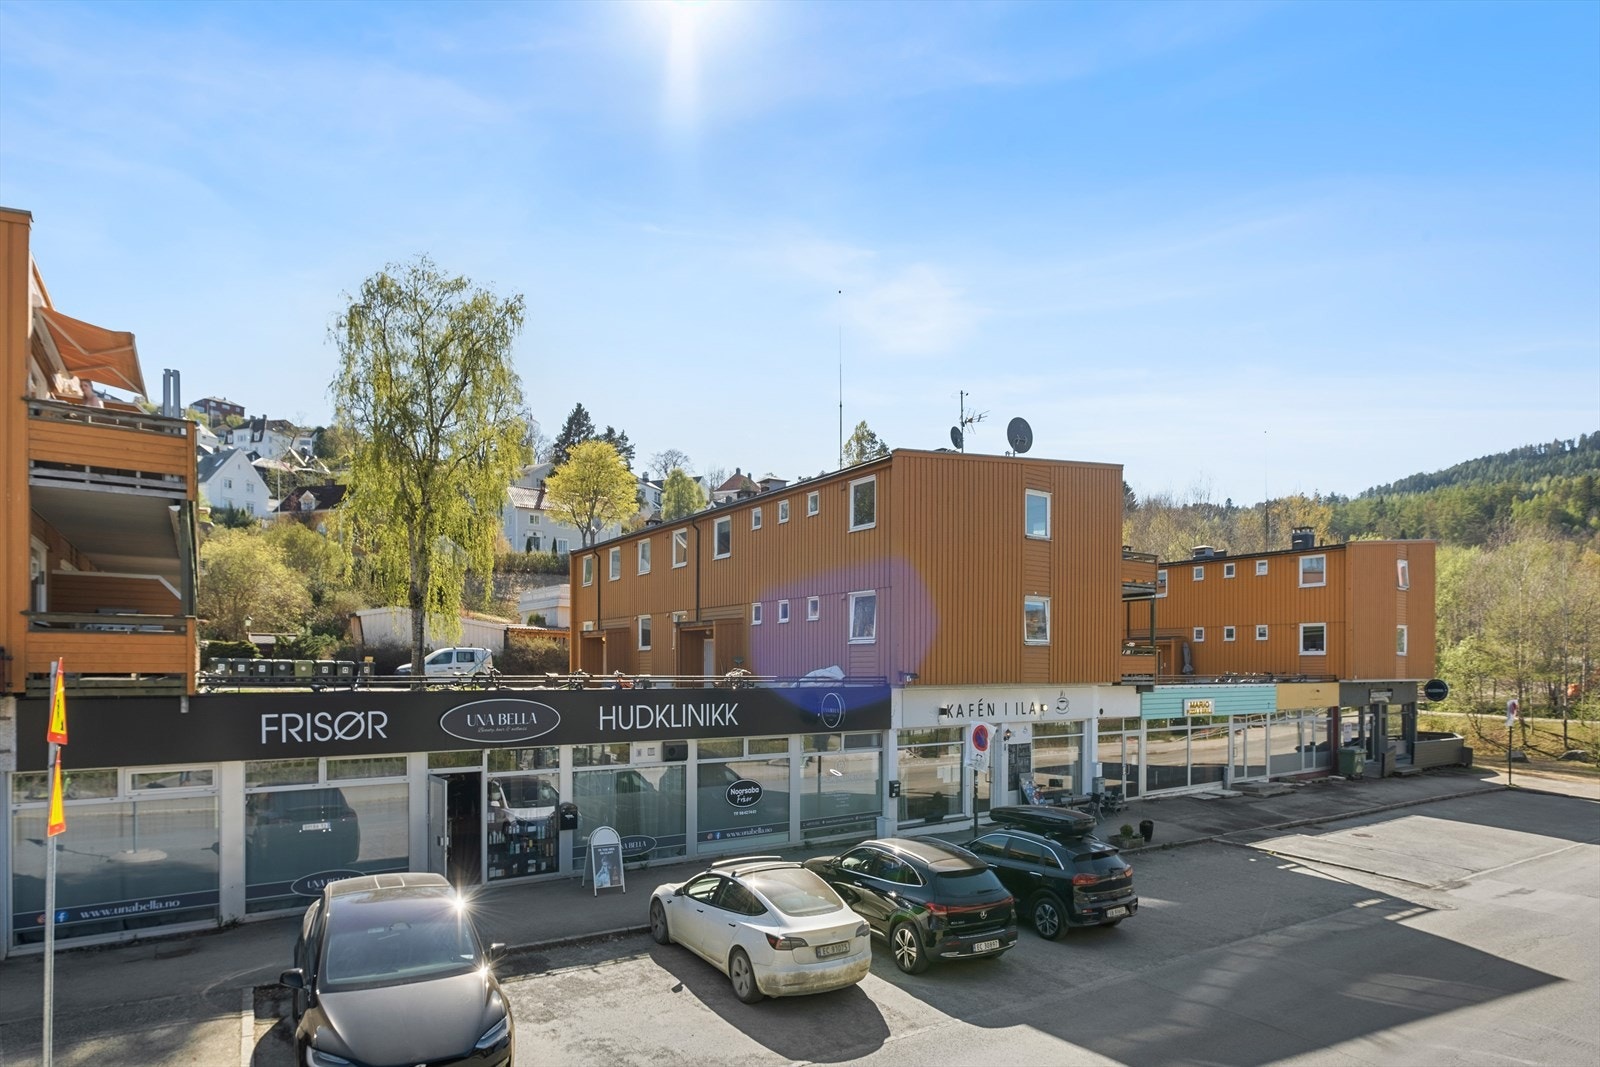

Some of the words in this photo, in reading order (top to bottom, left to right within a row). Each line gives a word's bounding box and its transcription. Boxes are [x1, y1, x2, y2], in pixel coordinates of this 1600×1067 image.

[599, 703, 739, 731] HUDKLINIKK
[946, 698, 995, 719] KAFÉN
[1004, 702, 1008, 716] I
[1015, 702, 1037, 716] ILA
[261, 710, 389, 744] FRISØR
[466, 713, 495, 727] UNA
[498, 712, 538, 726] BELLA
[628, 840, 647, 849] BELLA
[80, 899, 181, 919] www.unabella.no
